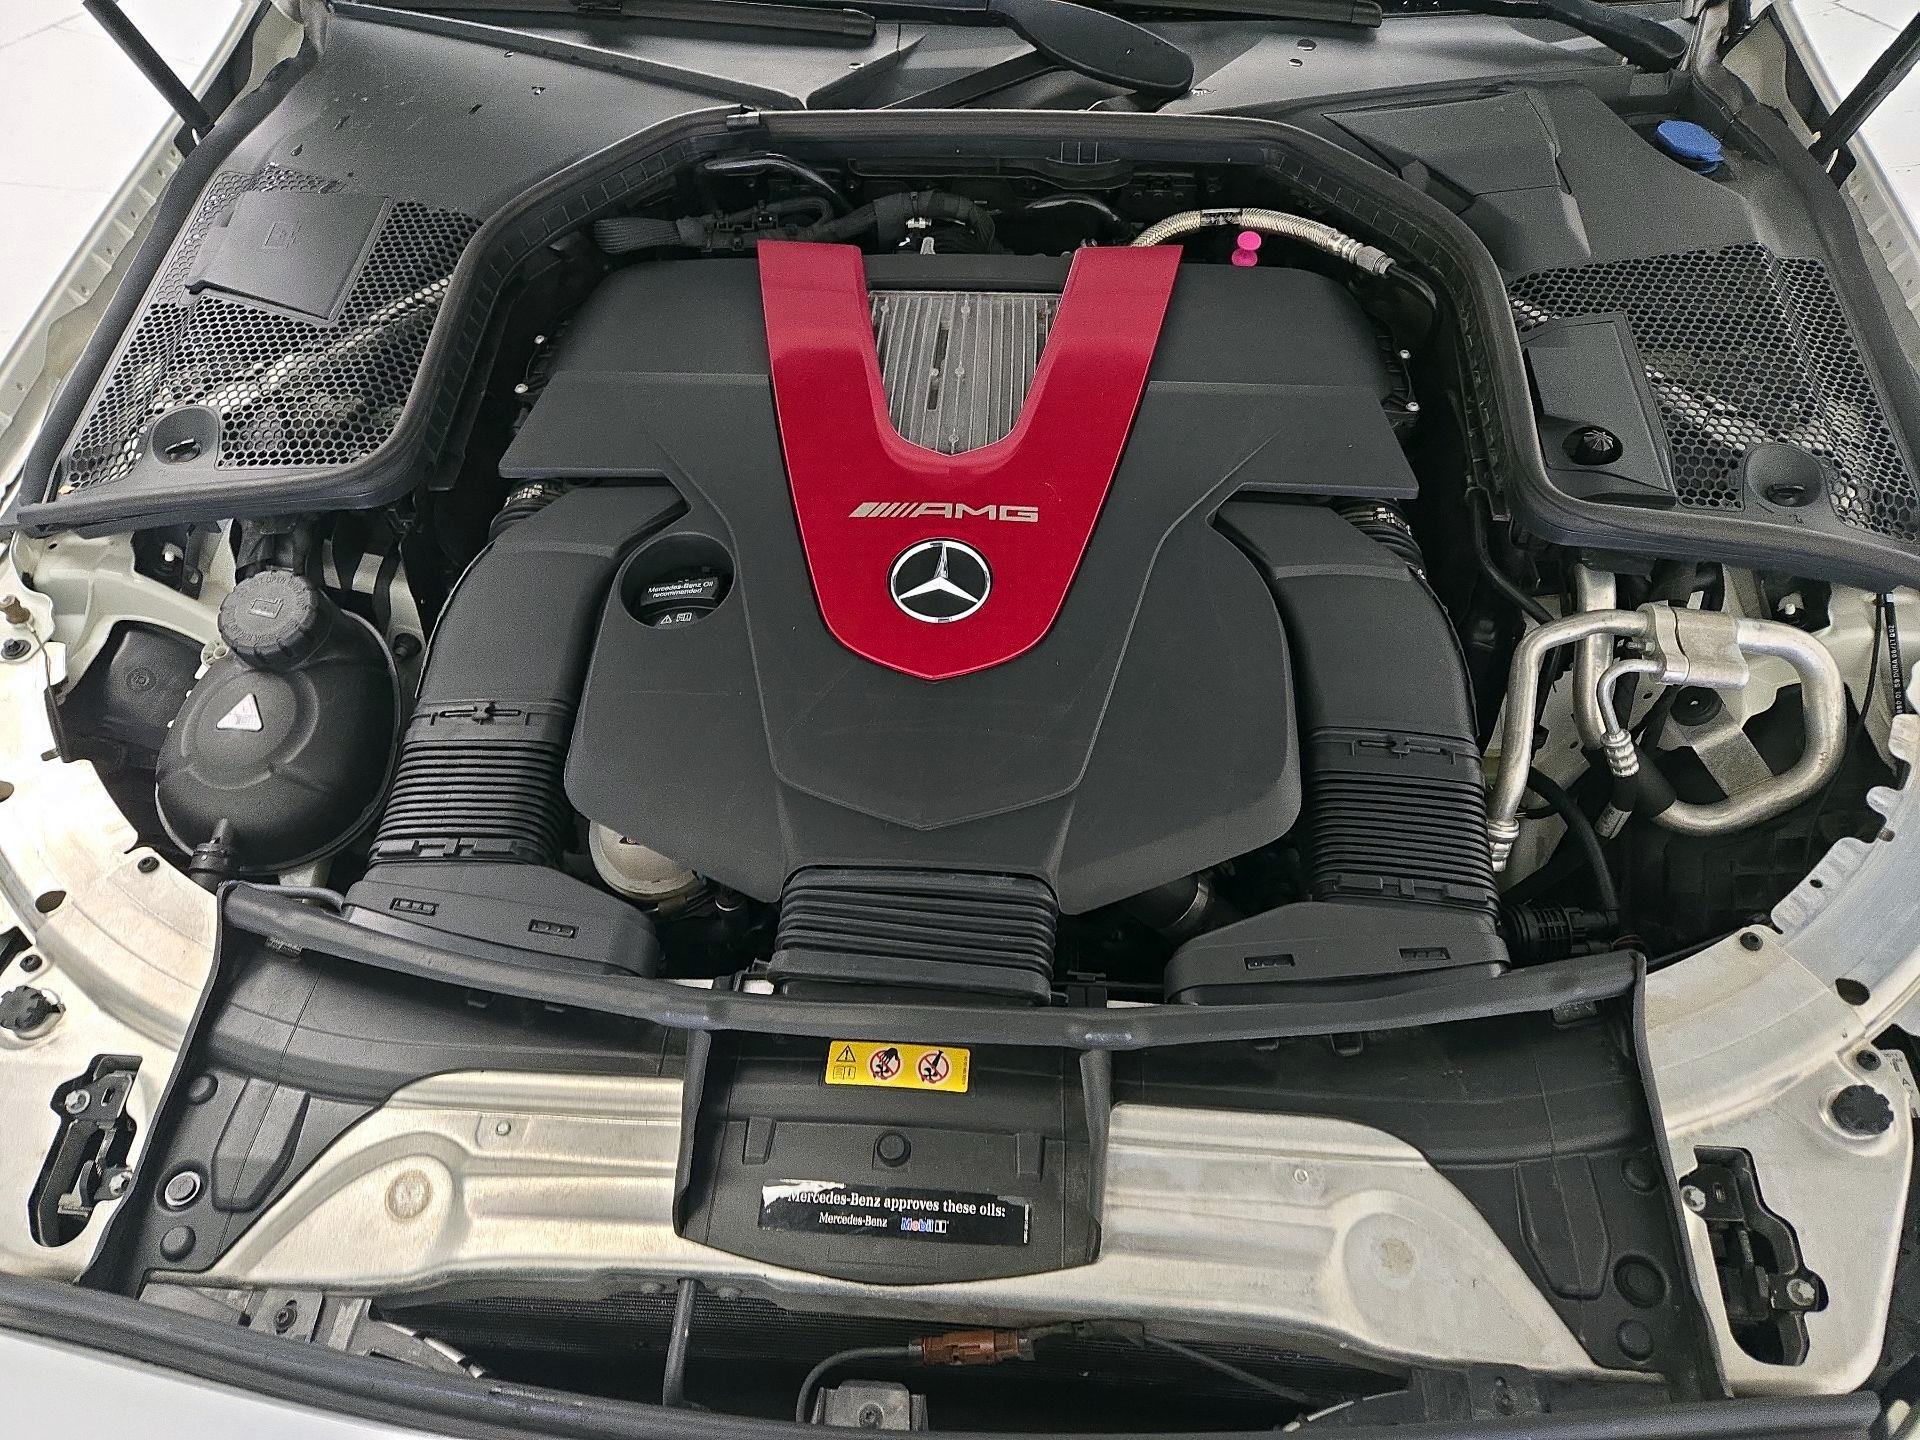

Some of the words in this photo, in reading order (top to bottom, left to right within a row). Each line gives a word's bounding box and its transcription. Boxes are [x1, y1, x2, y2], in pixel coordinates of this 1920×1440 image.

[908, 502, 1039, 523] AMG
[647, 582, 702, 594] Mercedes-Benz
[652, 588, 703, 599] recommended
[883, 1196, 940, 1212] approves
[942, 1199, 977, 1215] these
[979, 1202, 1006, 1218] oils:
[818, 1211, 888, 1228] Mercedes-Benz
[900, 1216, 934, 1233] Mobil
